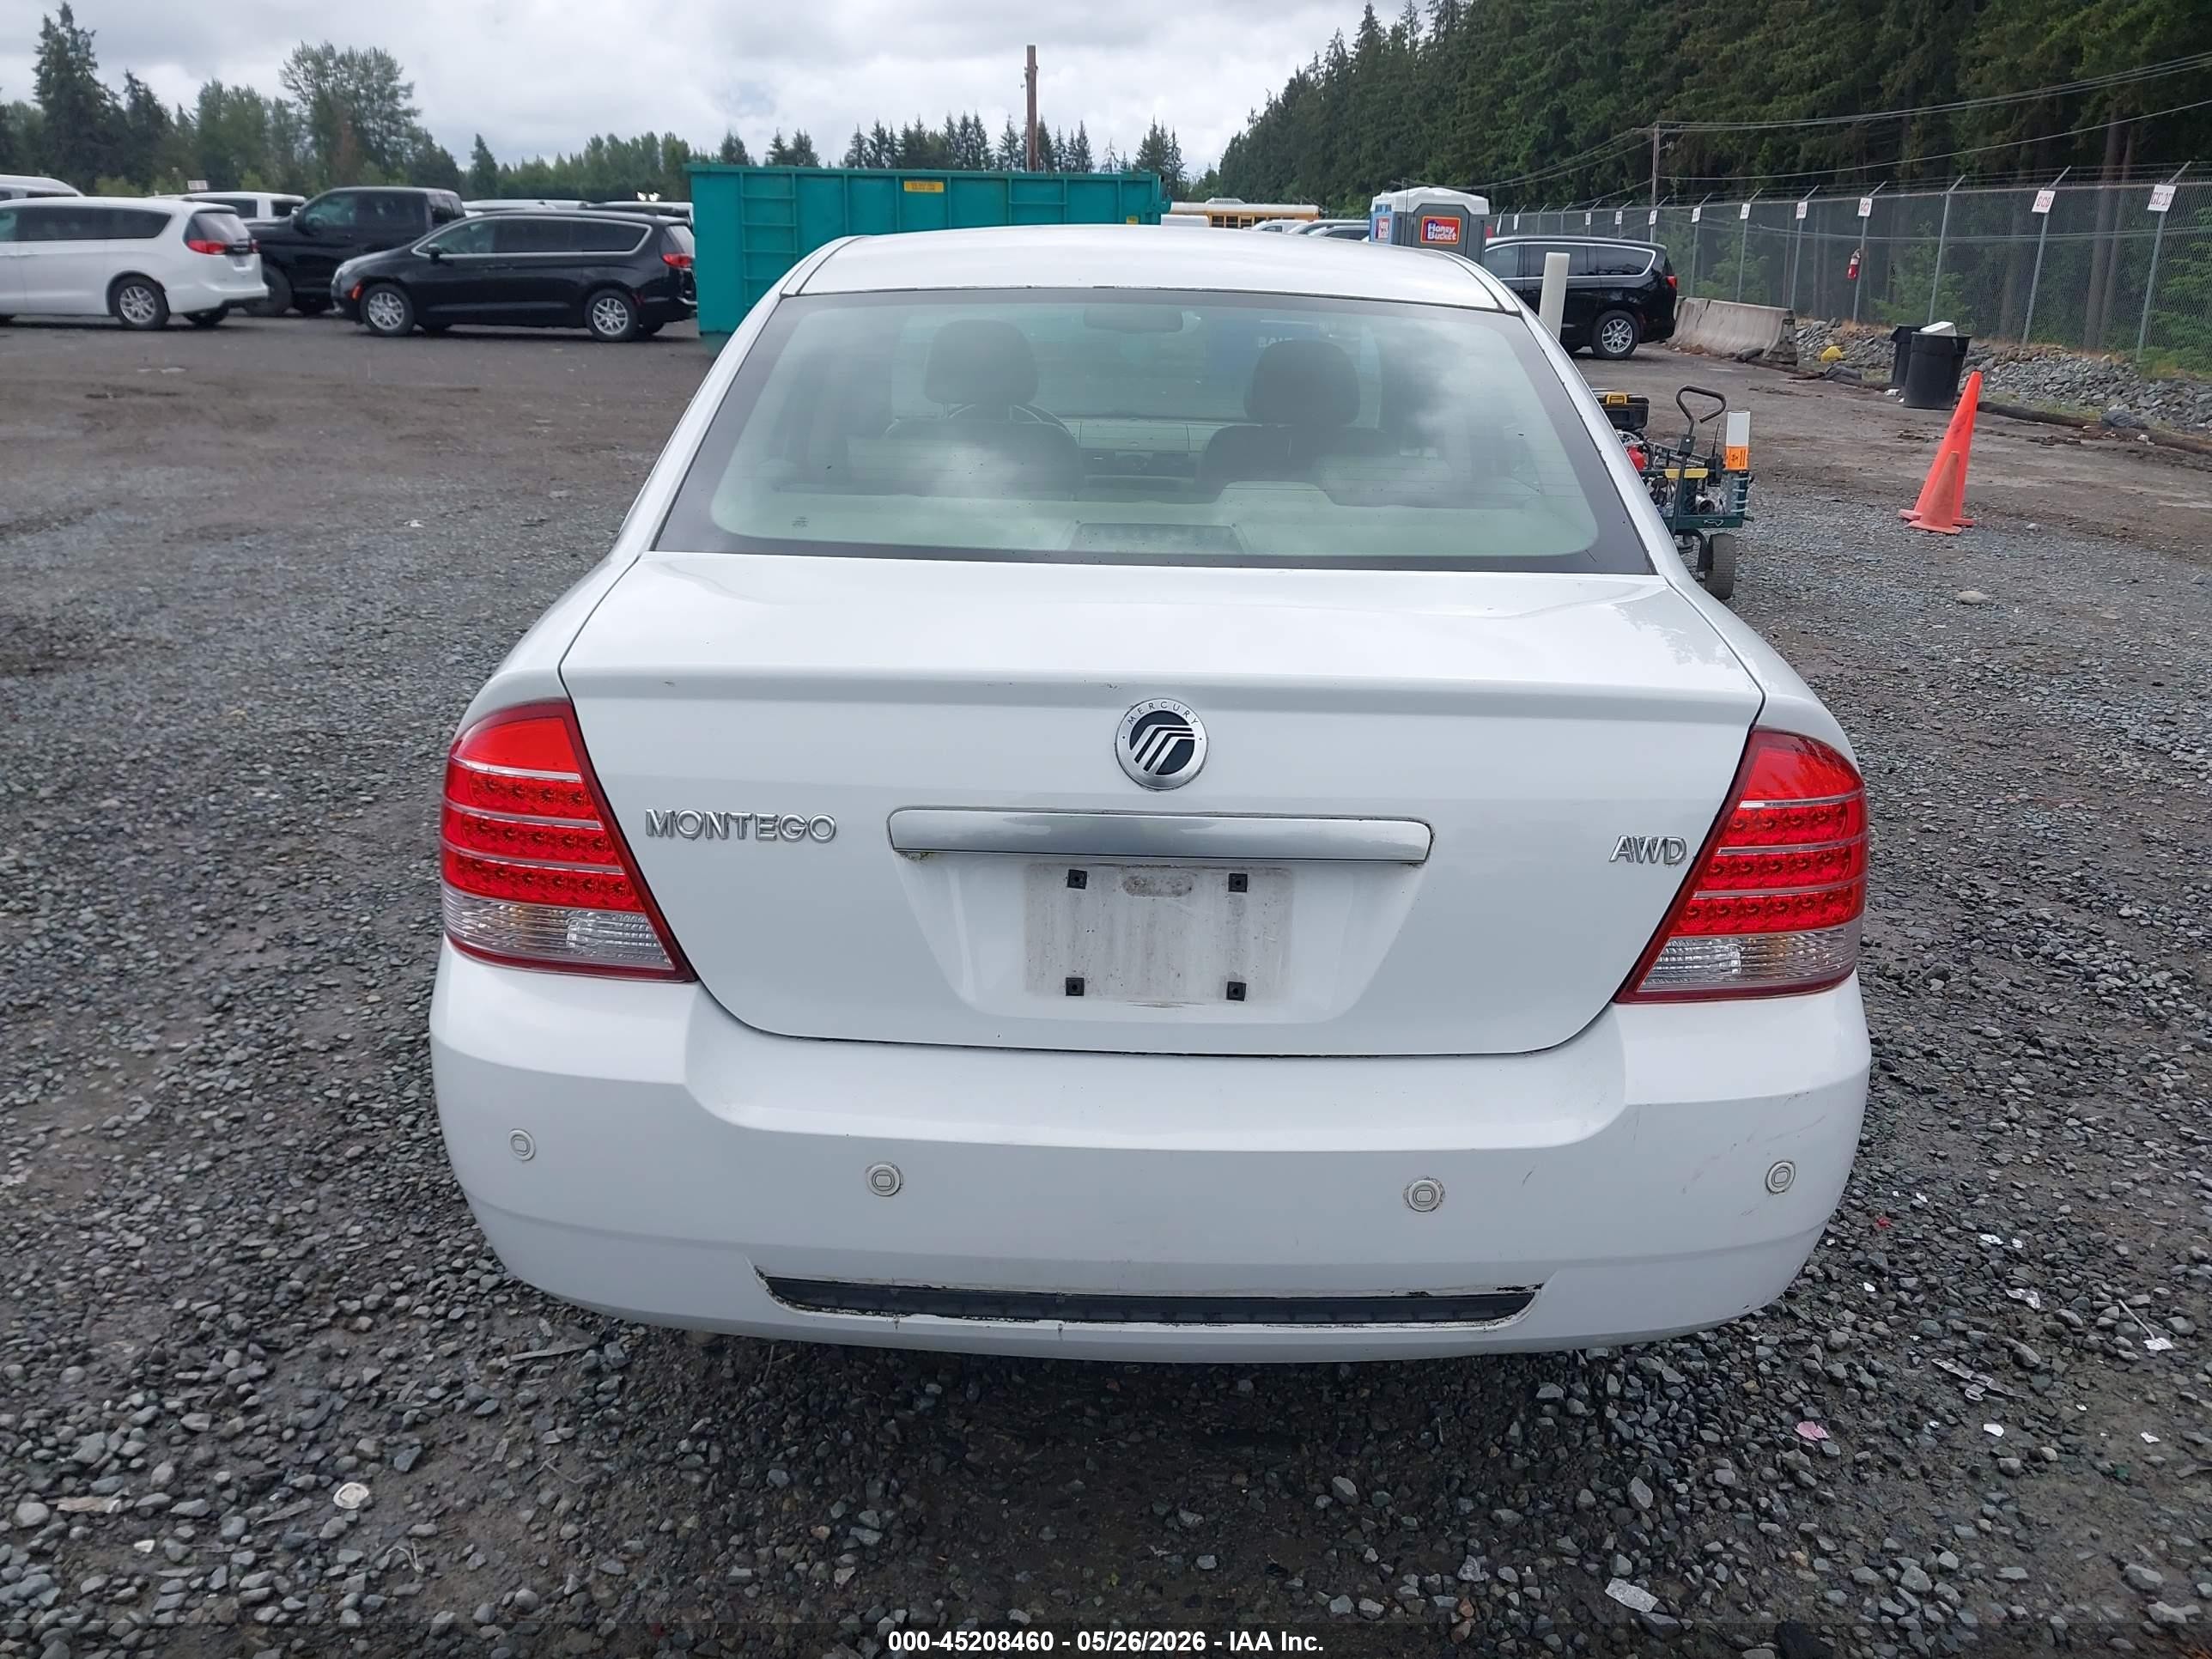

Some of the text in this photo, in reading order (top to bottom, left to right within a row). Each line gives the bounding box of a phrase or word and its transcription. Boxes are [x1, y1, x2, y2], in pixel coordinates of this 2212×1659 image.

[1427, 222, 1456, 234] Honey
[1427, 231, 1457, 240] Bucket
[1127, 701, 1199, 726] MERCURY
[645, 808, 838, 844] MONTEGO
[1608, 835, 1687, 865] AWD
